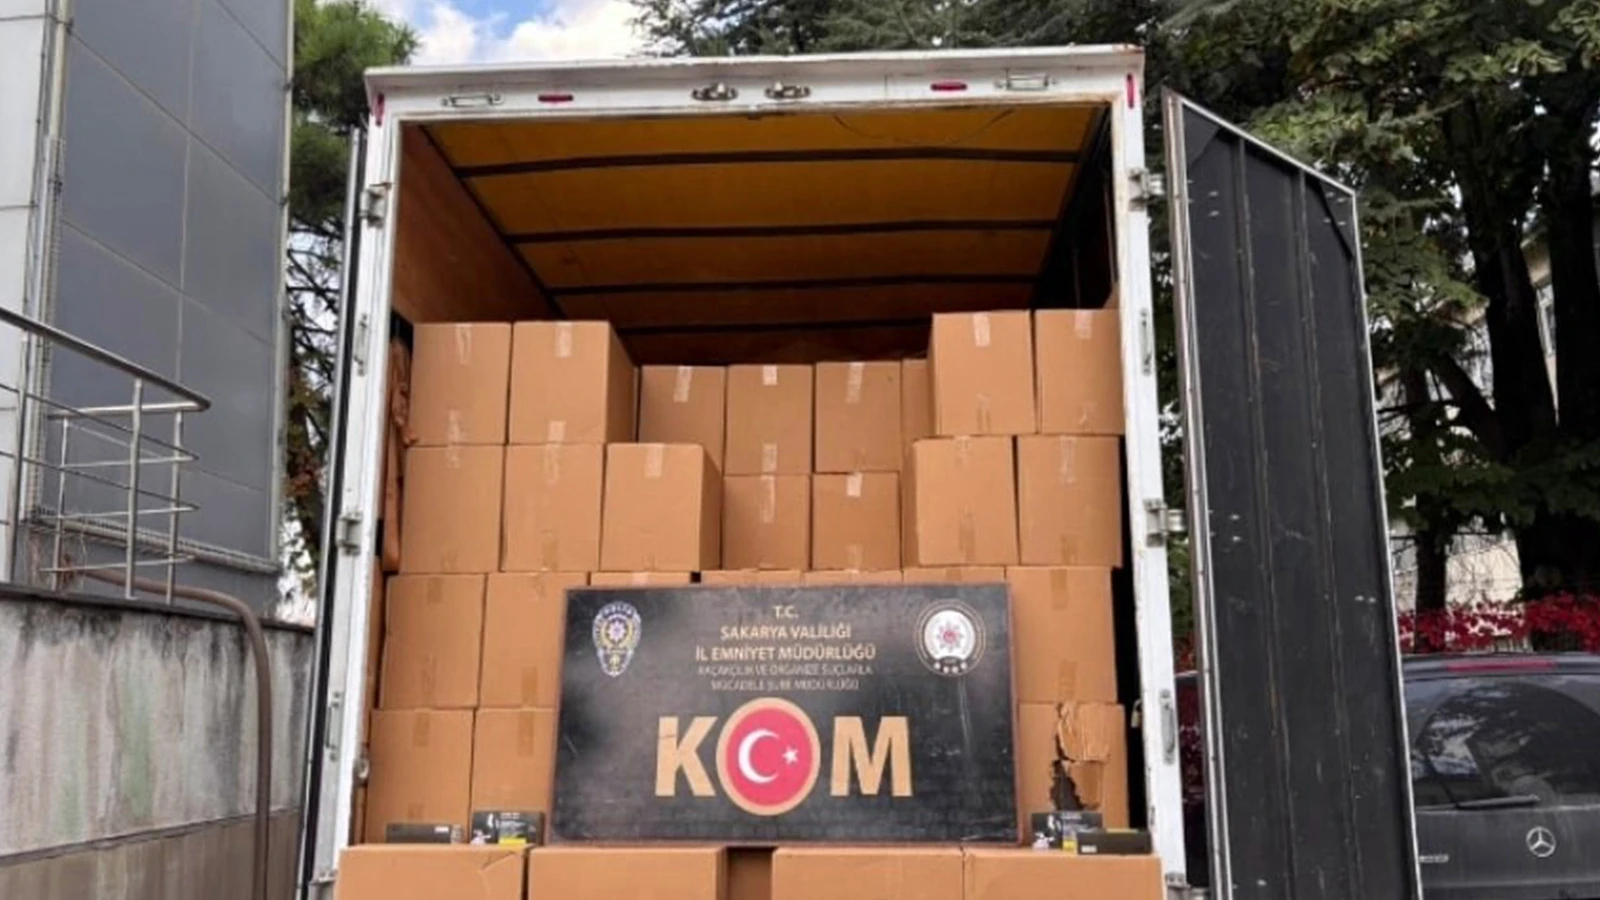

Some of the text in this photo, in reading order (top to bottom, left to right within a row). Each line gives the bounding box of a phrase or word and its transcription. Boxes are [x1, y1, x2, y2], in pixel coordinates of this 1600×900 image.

[774, 605, 799, 619] T.C.
[720, 622, 852, 640] SAKARYA VALİLİĞİ
[711, 645, 775, 661] EMNİYET
[778, 643, 876, 661] MÜDÜRLÜĞÜ
